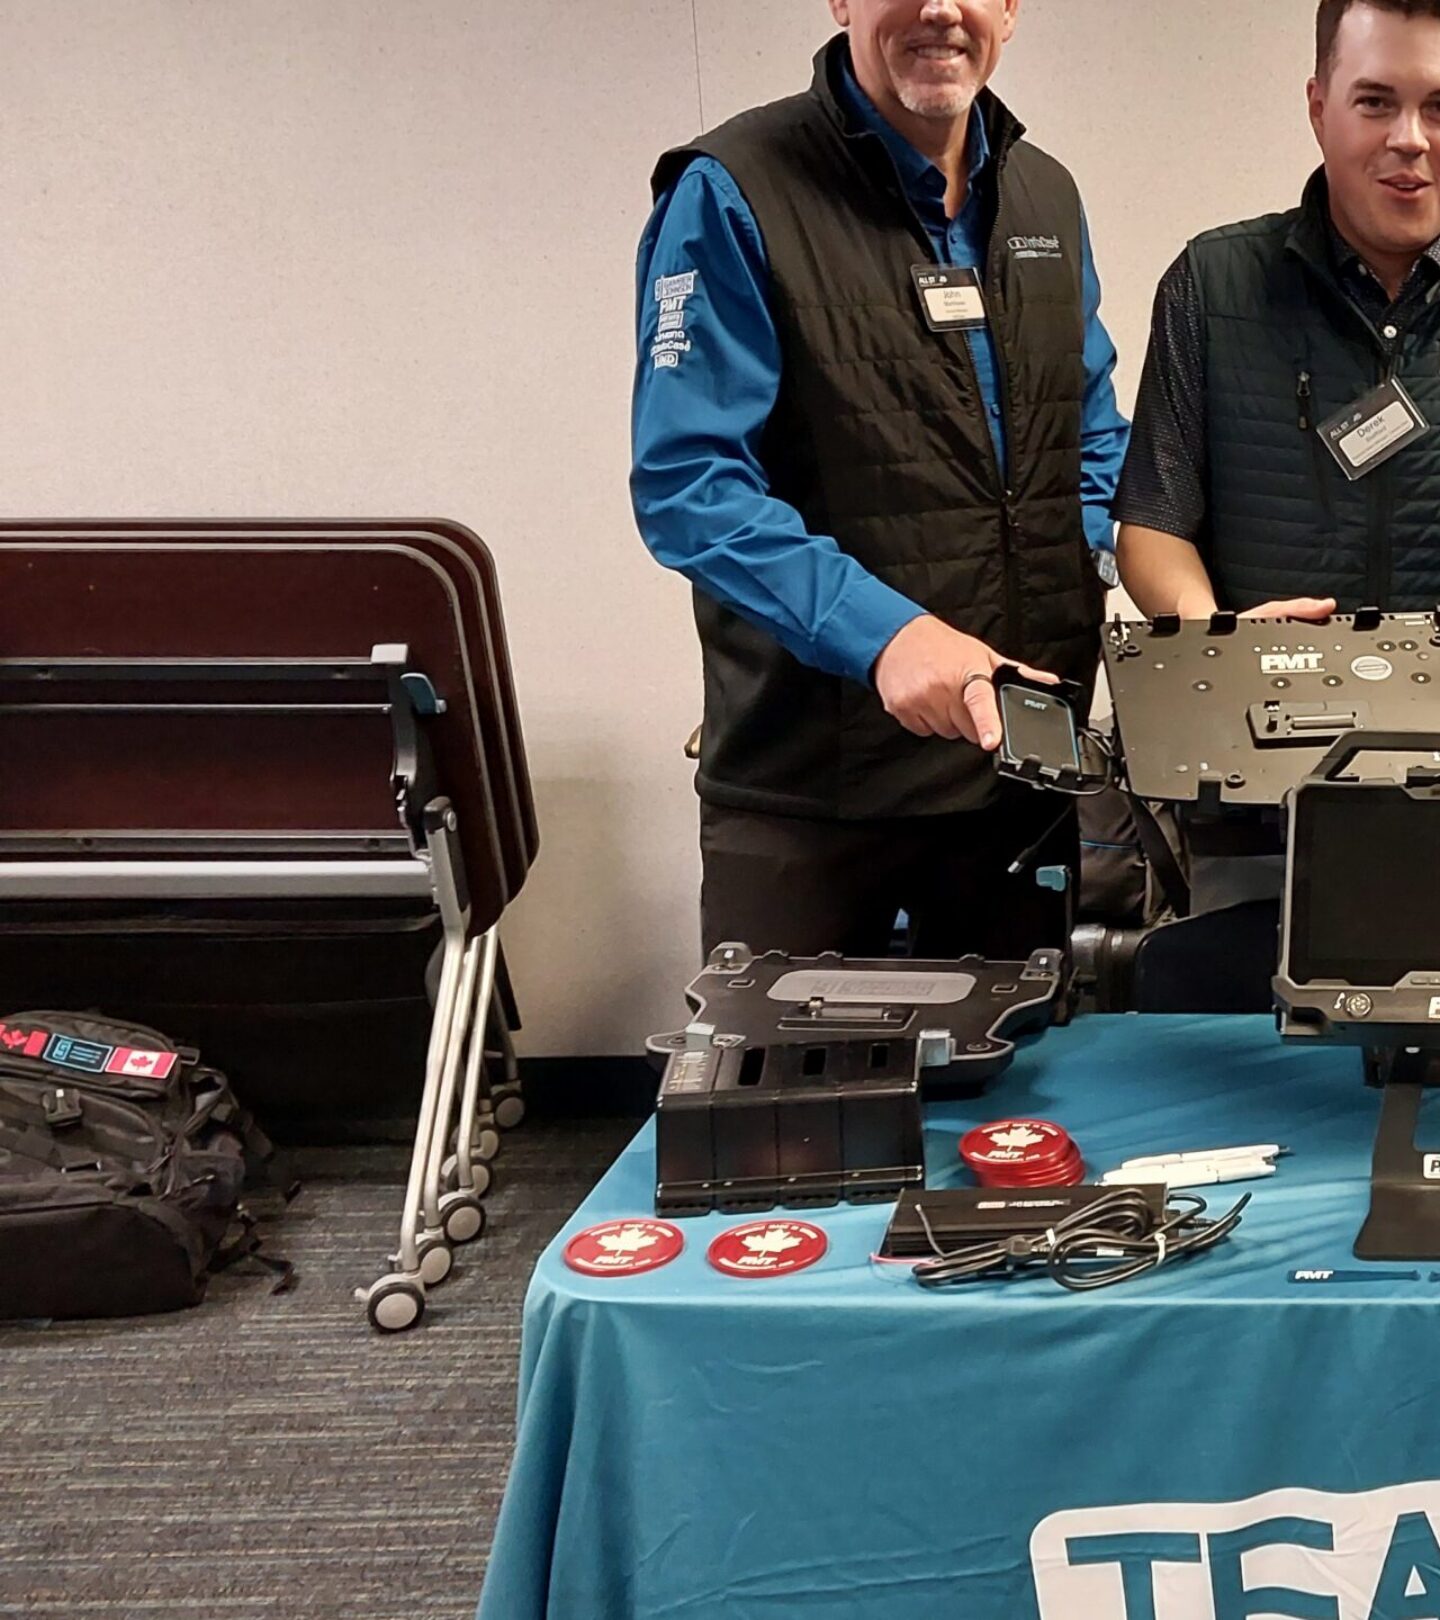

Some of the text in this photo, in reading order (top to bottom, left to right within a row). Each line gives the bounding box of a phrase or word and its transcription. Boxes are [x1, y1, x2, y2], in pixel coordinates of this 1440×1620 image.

[660, 296, 687, 314] PMT
[1356, 415, 1384, 438] Derek
[1260, 653, 1324, 671] PMT
[1024, 699, 1048, 710] PMT
[987, 1150, 1025, 1159] PMT
[593, 1255, 635, 1265] PMT
[737, 1256, 778, 1266] PMT
[1295, 1270, 1334, 1279] PMT
